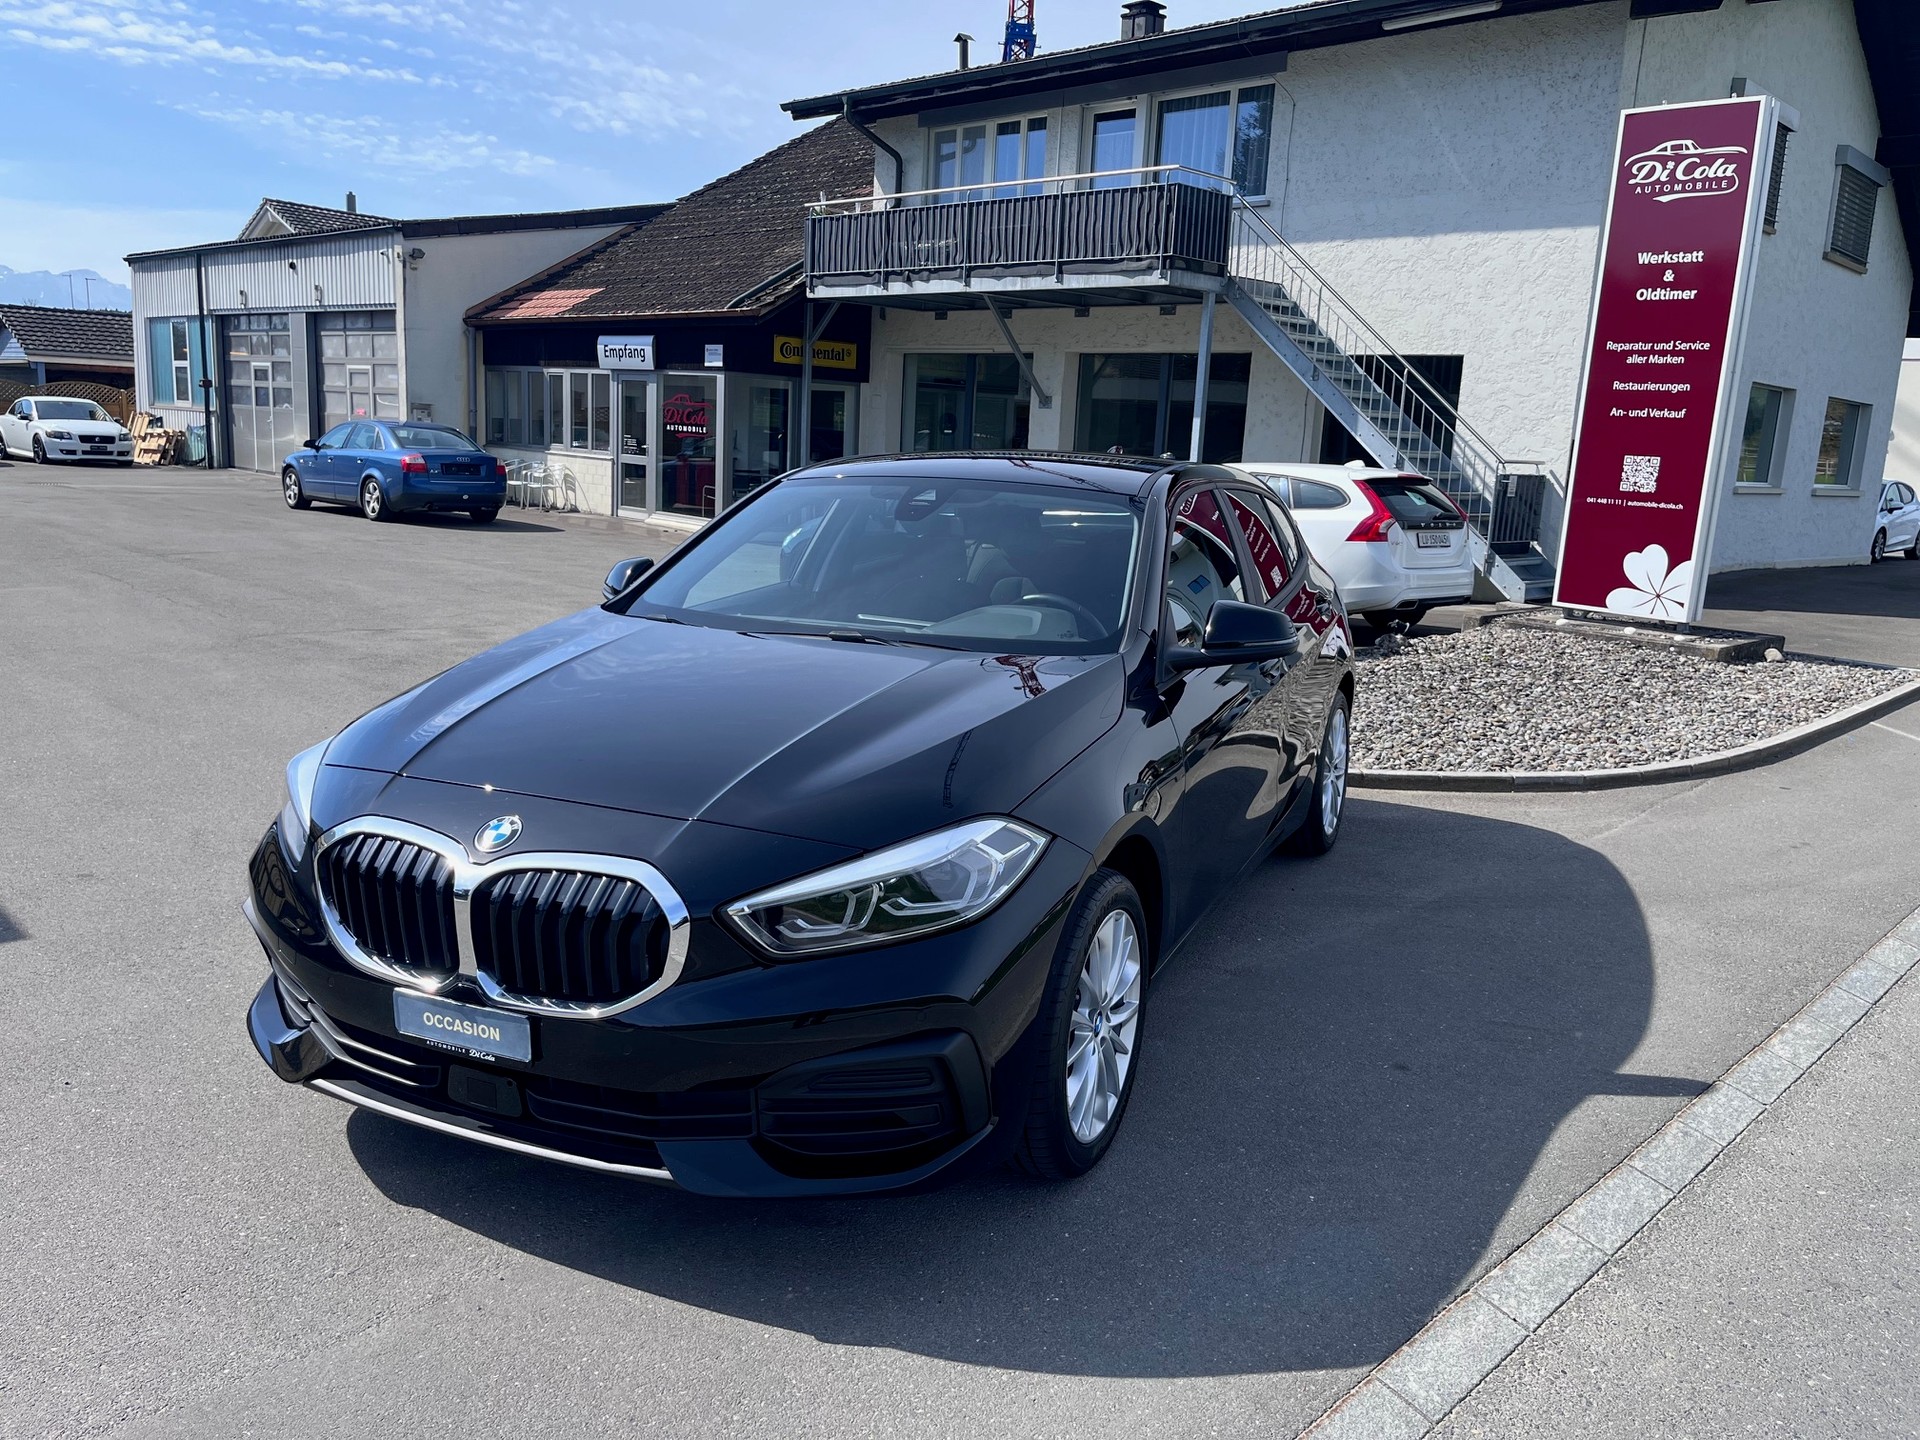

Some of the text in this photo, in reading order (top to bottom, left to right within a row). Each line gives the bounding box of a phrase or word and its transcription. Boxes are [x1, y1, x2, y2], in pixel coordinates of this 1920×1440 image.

[1676, 158, 1737, 181] Cola
[1635, 180, 1728, 194] AUTOMOBILE
[1637, 250, 1704, 264] Werkstatt
[1663, 269, 1675, 282] &
[1636, 287, 1697, 301] Oldtimer
[604, 344, 646, 362] Empfang
[1606, 341, 1710, 352] Reparatur und Service
[1626, 354, 1685, 364] aller Marken
[1613, 381, 1690, 393] Restaurierungen
[1610, 407, 1687, 418] An- und Verkauf
[666, 424, 707, 433] AUTOMOBILE
[1627, 501, 1684, 510] automobile-dicola.ch
[423, 1012, 500, 1041] OCCASION
[426, 1040, 466, 1054] AUTOMOBILE
